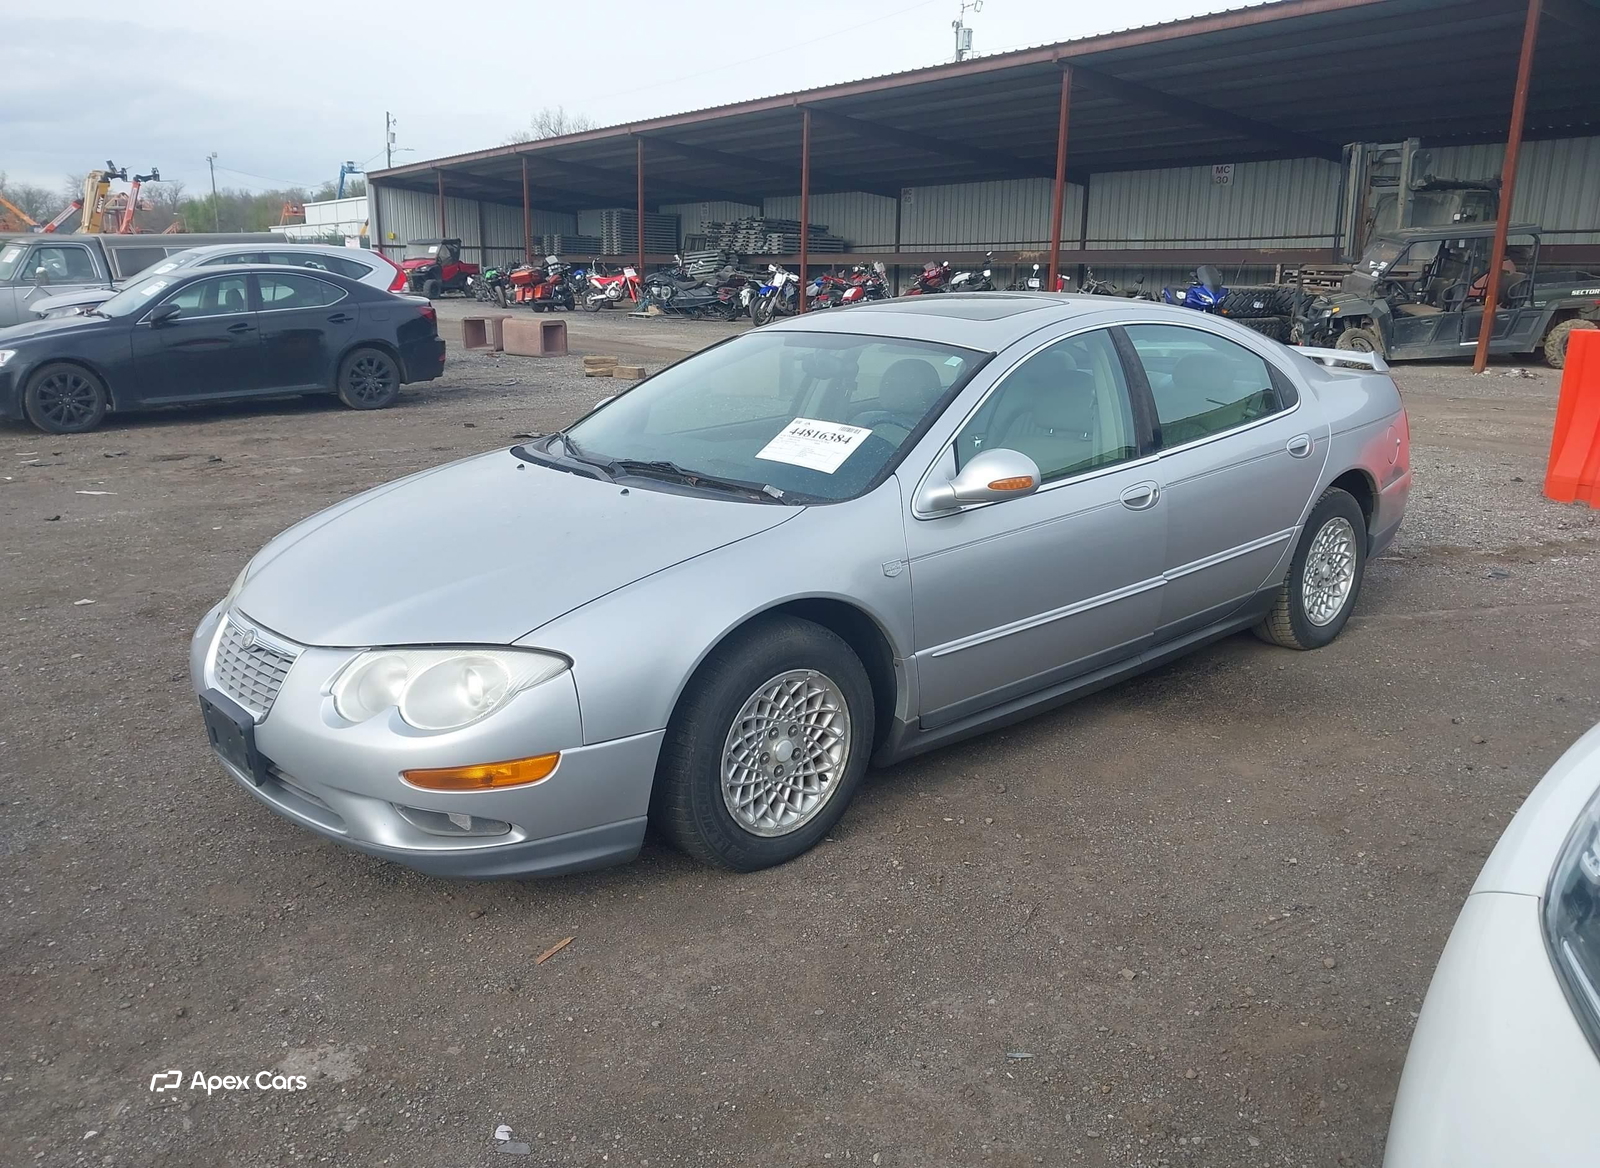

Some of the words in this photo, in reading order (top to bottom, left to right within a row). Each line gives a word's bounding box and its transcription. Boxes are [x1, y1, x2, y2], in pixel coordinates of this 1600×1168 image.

[1215, 165, 1231, 174] MC
[1215, 176, 1229, 184] 30
[1571, 288, 1600, 296] SECTOR
[789, 427, 852, 445] 44816384
